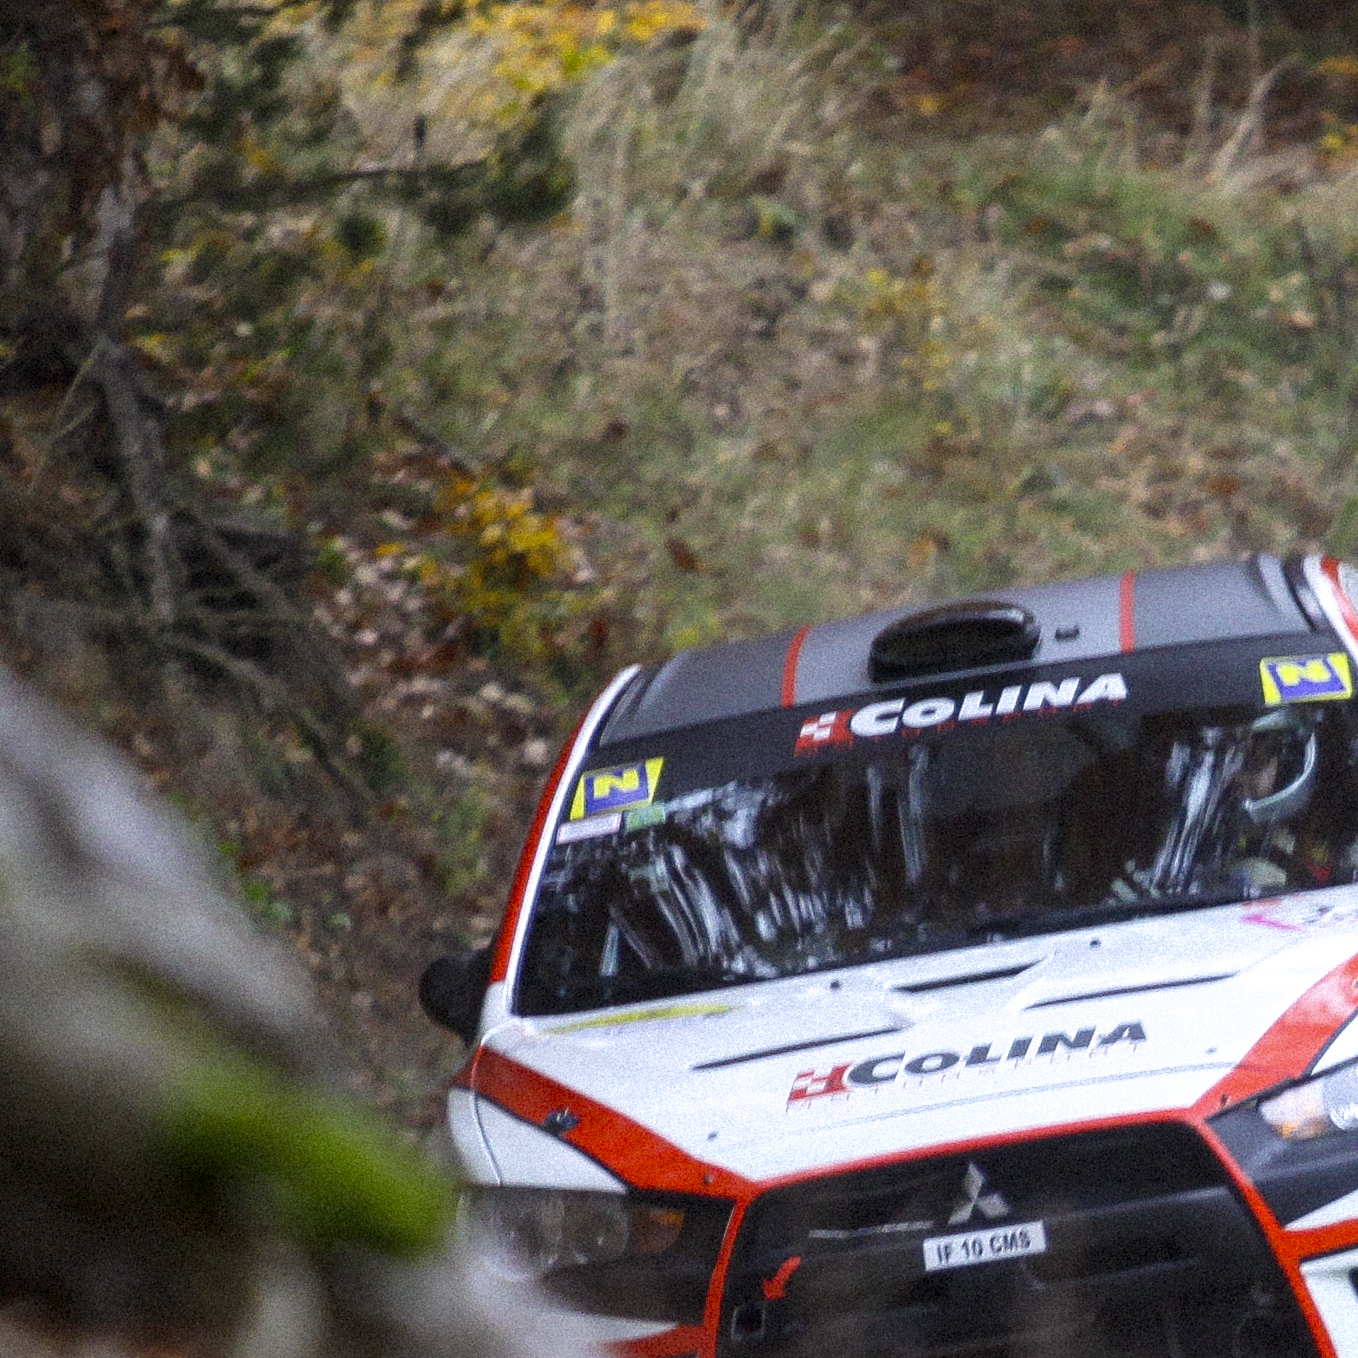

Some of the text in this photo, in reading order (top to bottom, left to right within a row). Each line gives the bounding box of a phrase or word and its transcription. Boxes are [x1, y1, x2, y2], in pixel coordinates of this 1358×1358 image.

[850, 672, 1127, 737] COLINA
[848, 1022, 1146, 1084] COLINA
[961, 1238, 983, 1259] 10
